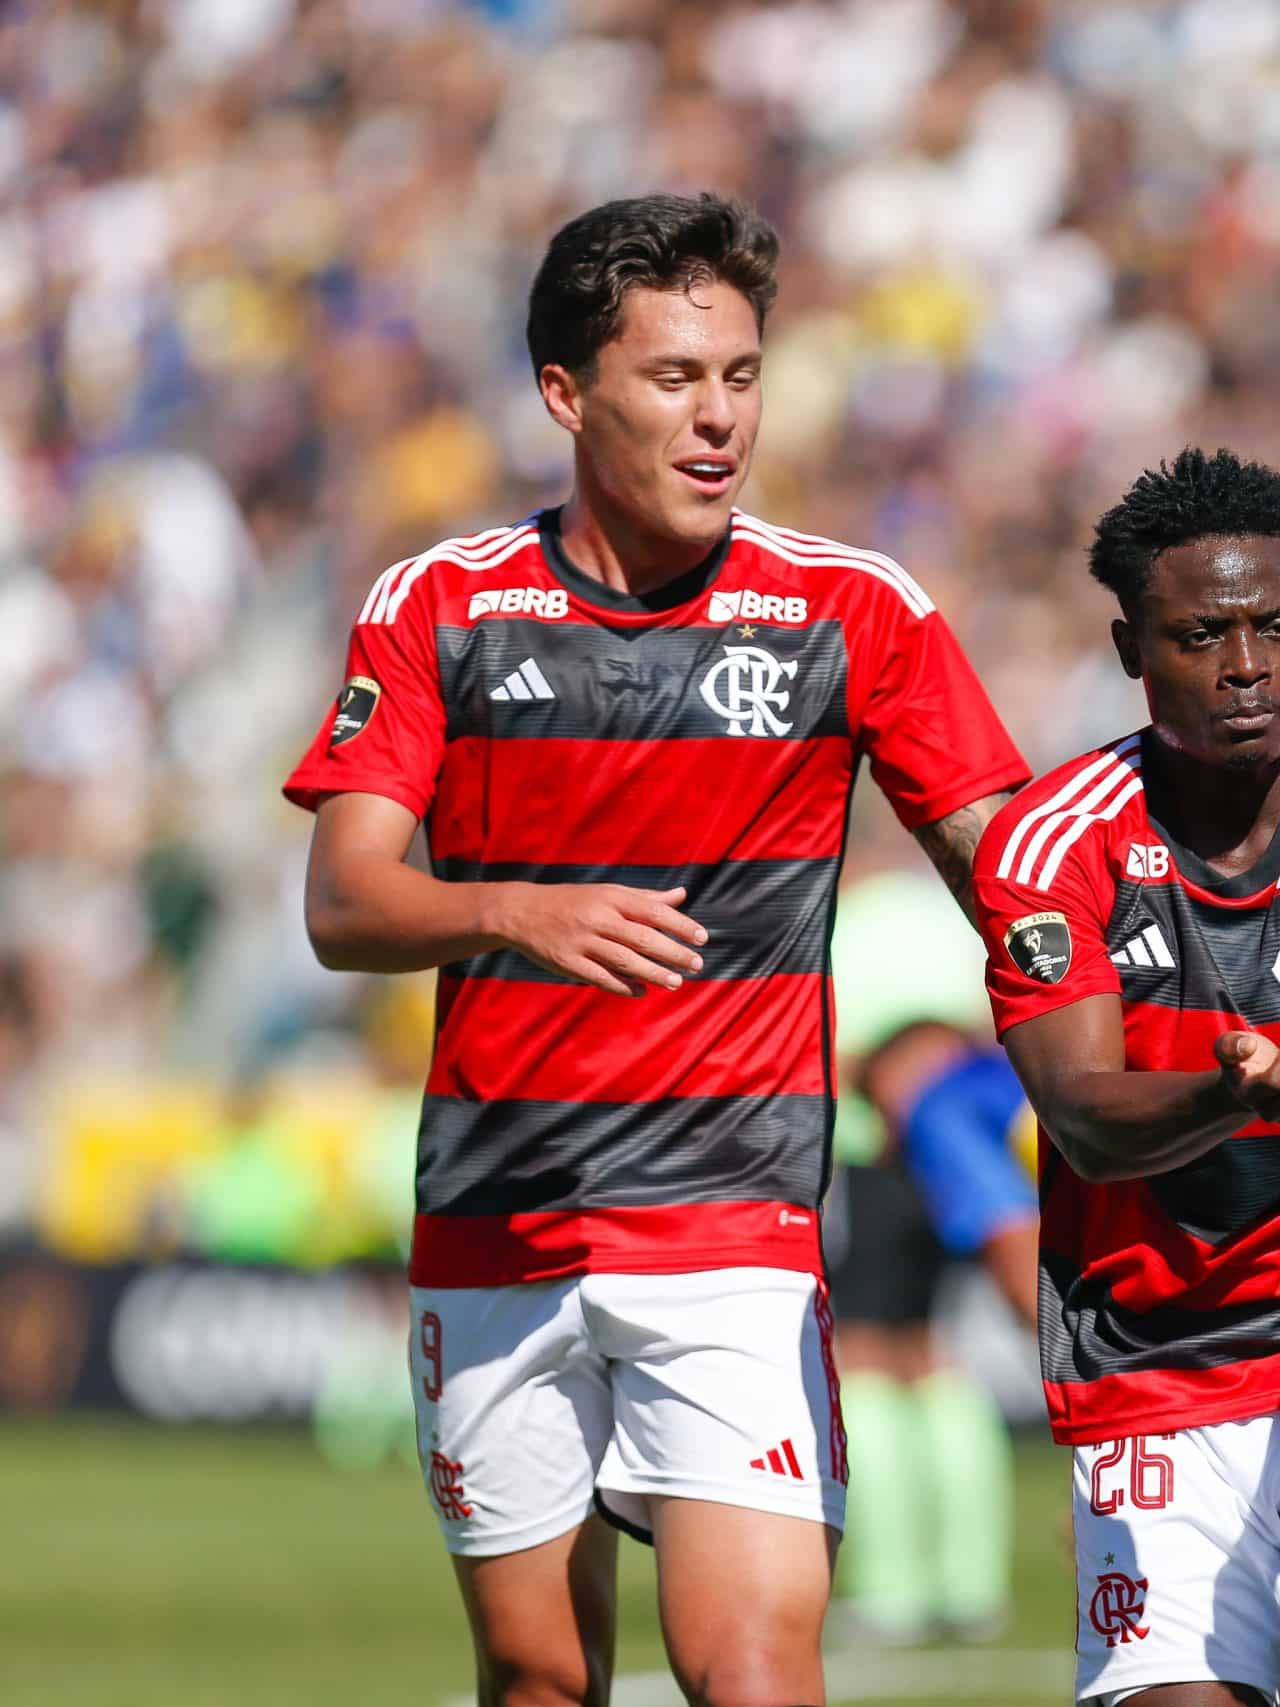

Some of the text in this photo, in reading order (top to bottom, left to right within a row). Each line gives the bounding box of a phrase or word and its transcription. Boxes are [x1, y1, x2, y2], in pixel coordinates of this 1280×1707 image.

[500, 587, 569, 619] BRB
[739, 589, 808, 623] BRB
[421, 1311, 442, 1403] 9
[1090, 1431, 1176, 1516] 26
